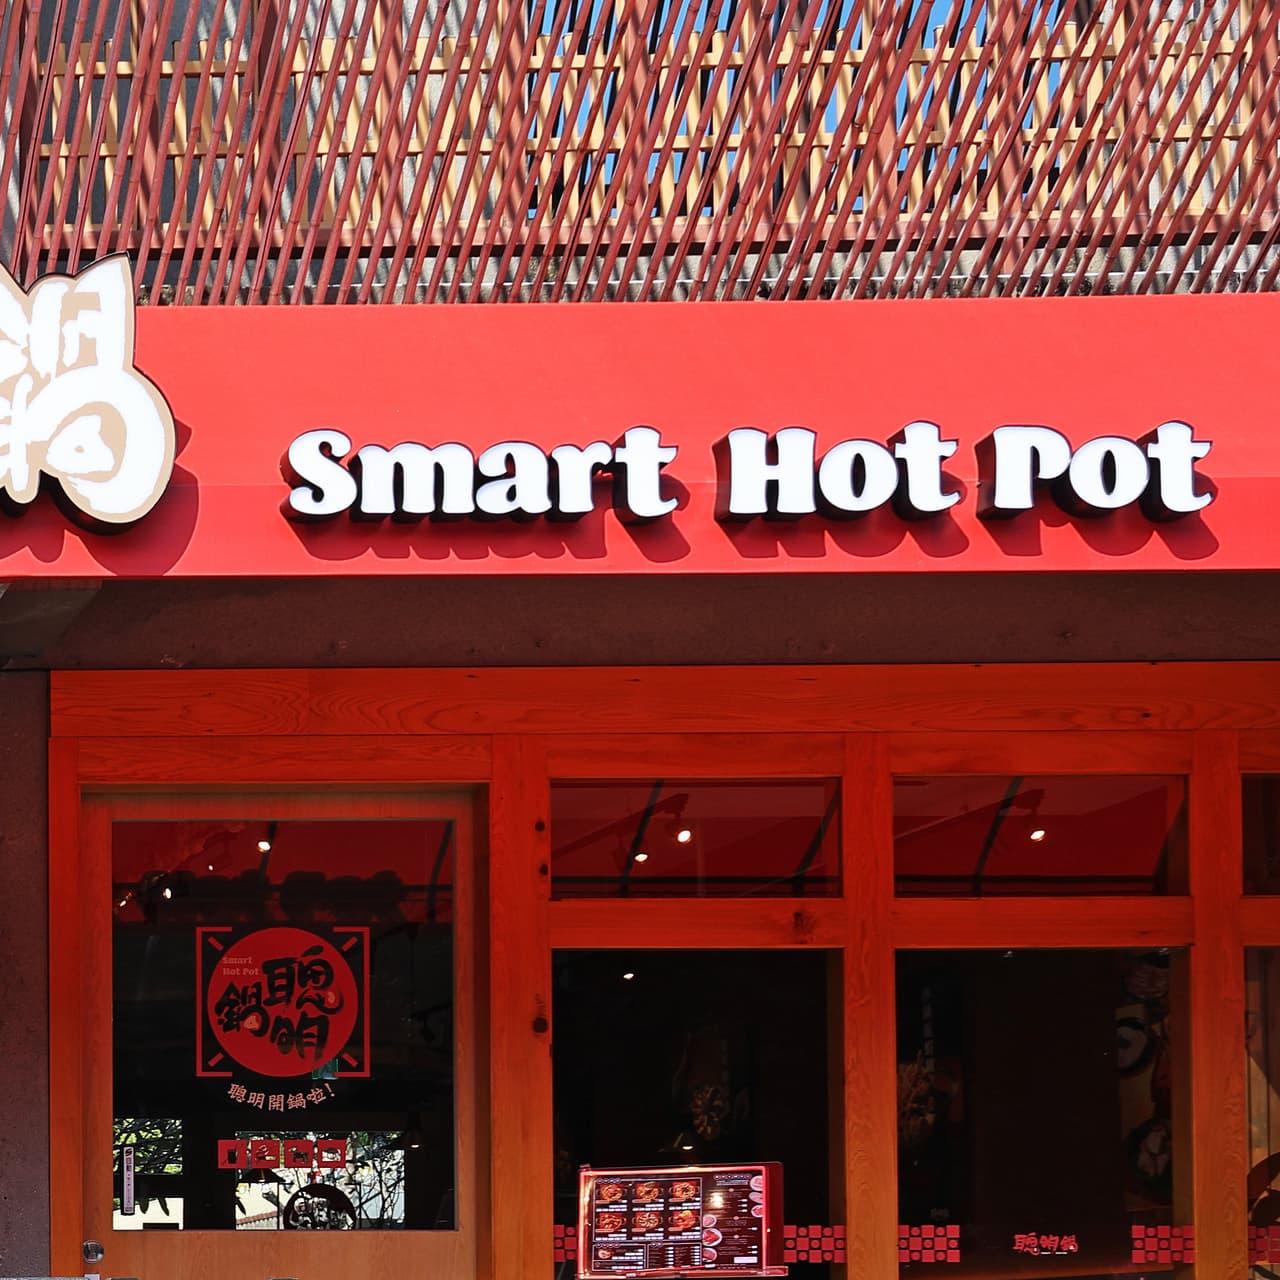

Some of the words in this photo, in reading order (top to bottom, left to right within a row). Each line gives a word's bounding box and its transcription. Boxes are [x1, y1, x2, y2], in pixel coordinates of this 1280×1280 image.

[282, 426, 679, 520] Smart
[720, 421, 961, 515] Hot
[980, 421, 1213, 515] Pot
[222, 956, 253, 965] Smart
[223, 967, 241, 976] Hot
[242, 967, 260, 976] Pot
